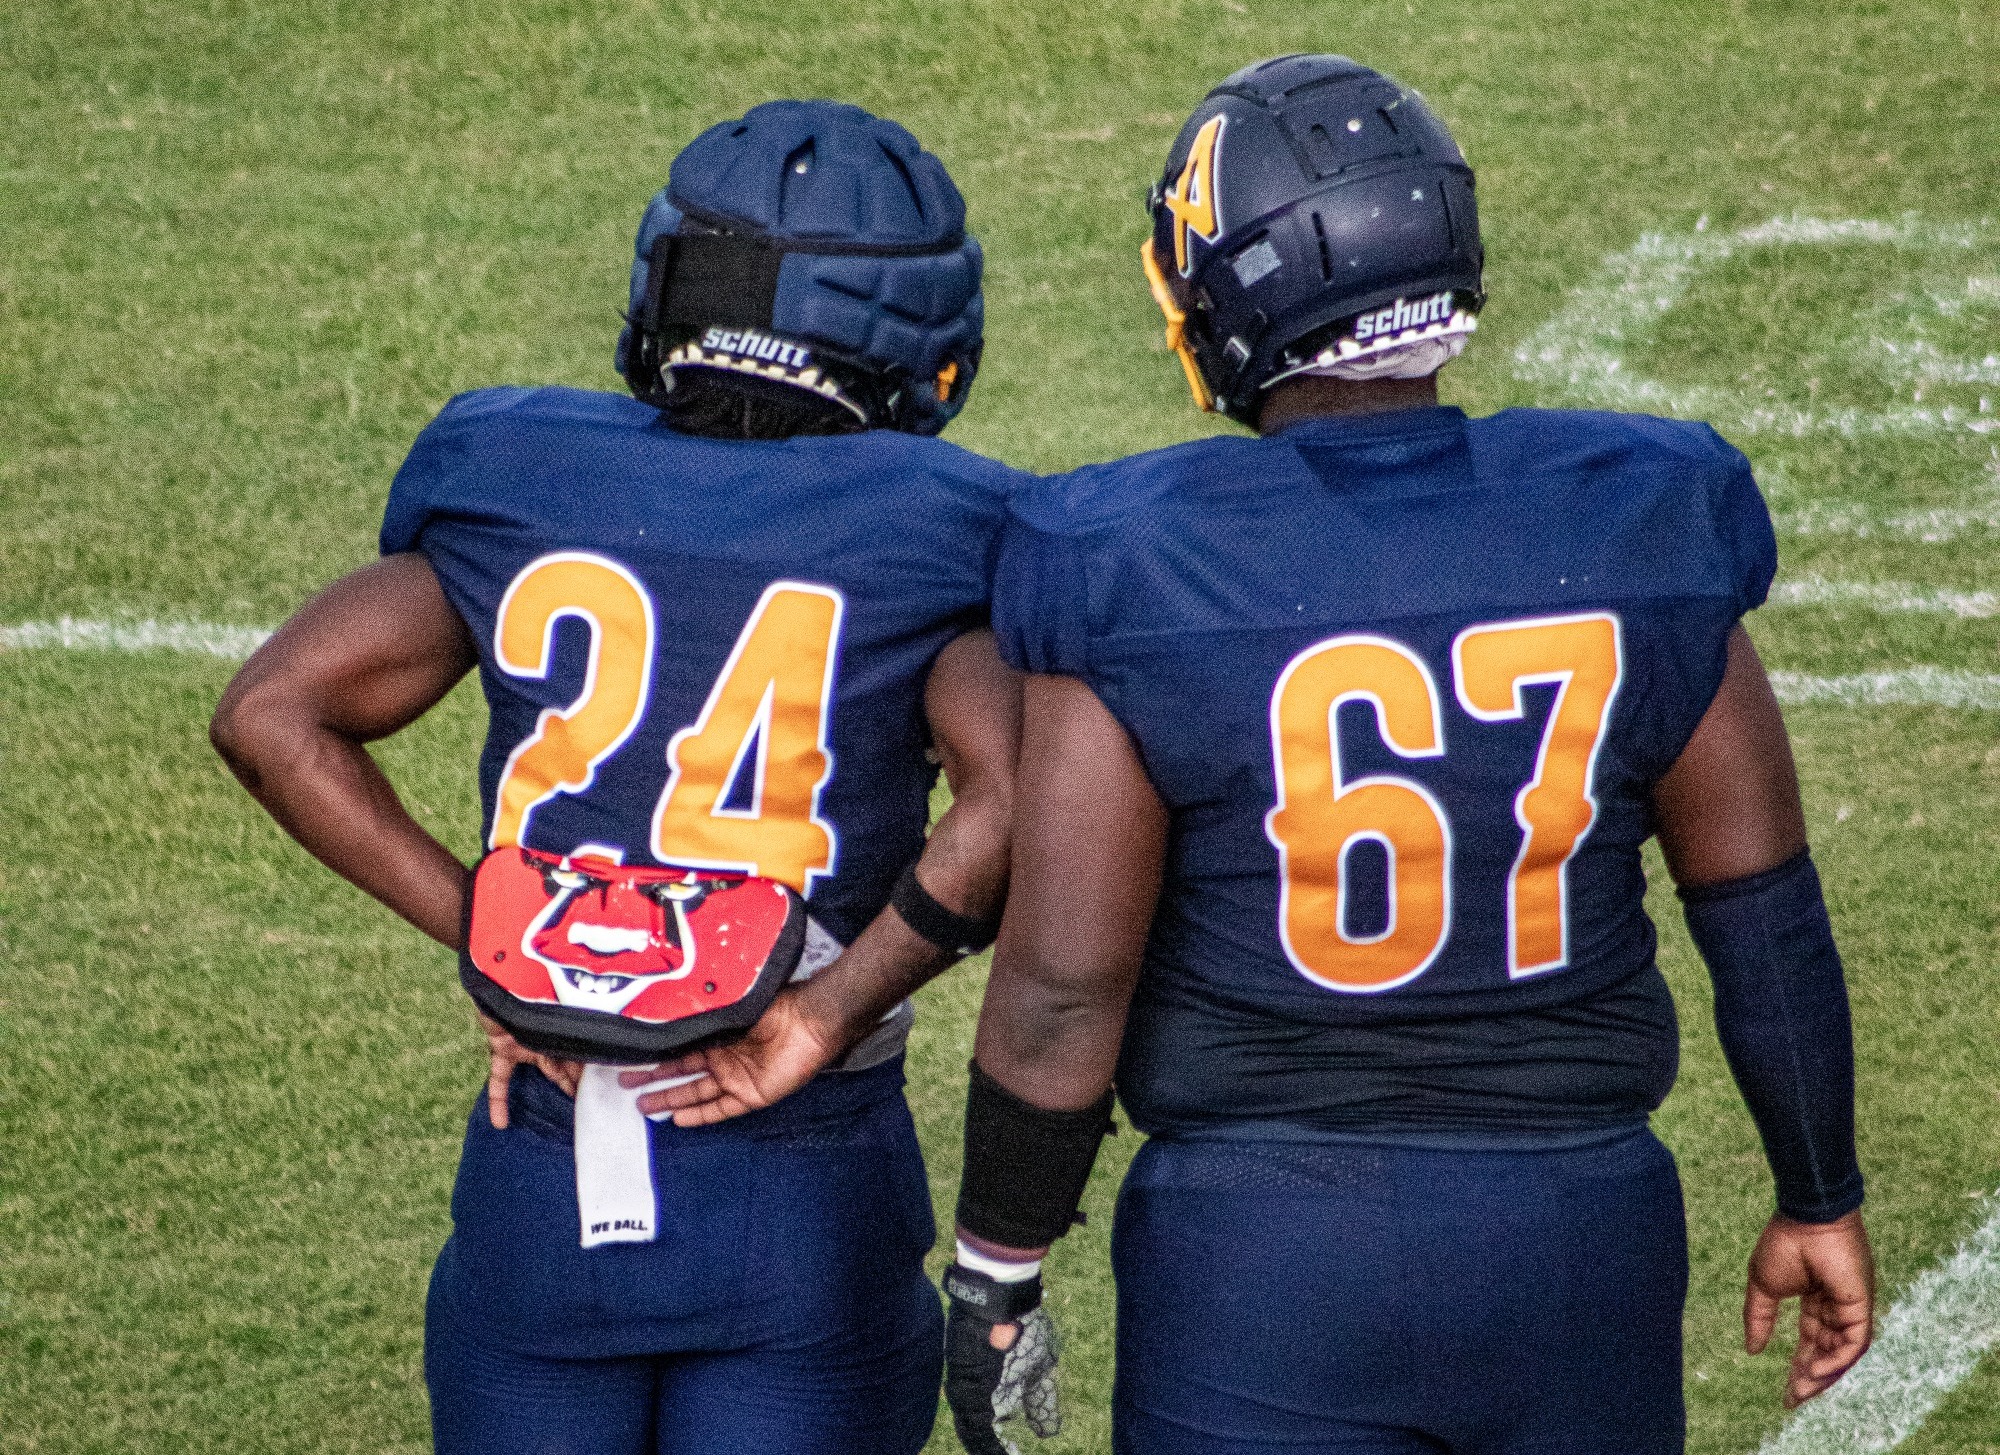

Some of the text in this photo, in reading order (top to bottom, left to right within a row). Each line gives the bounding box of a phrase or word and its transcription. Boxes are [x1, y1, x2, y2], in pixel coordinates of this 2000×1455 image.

[1355, 291, 1453, 340] schutt
[489, 551, 843, 900] 24
[1264, 612, 1623, 993] 67
[591, 1219, 648, 1235] WE BALL.
